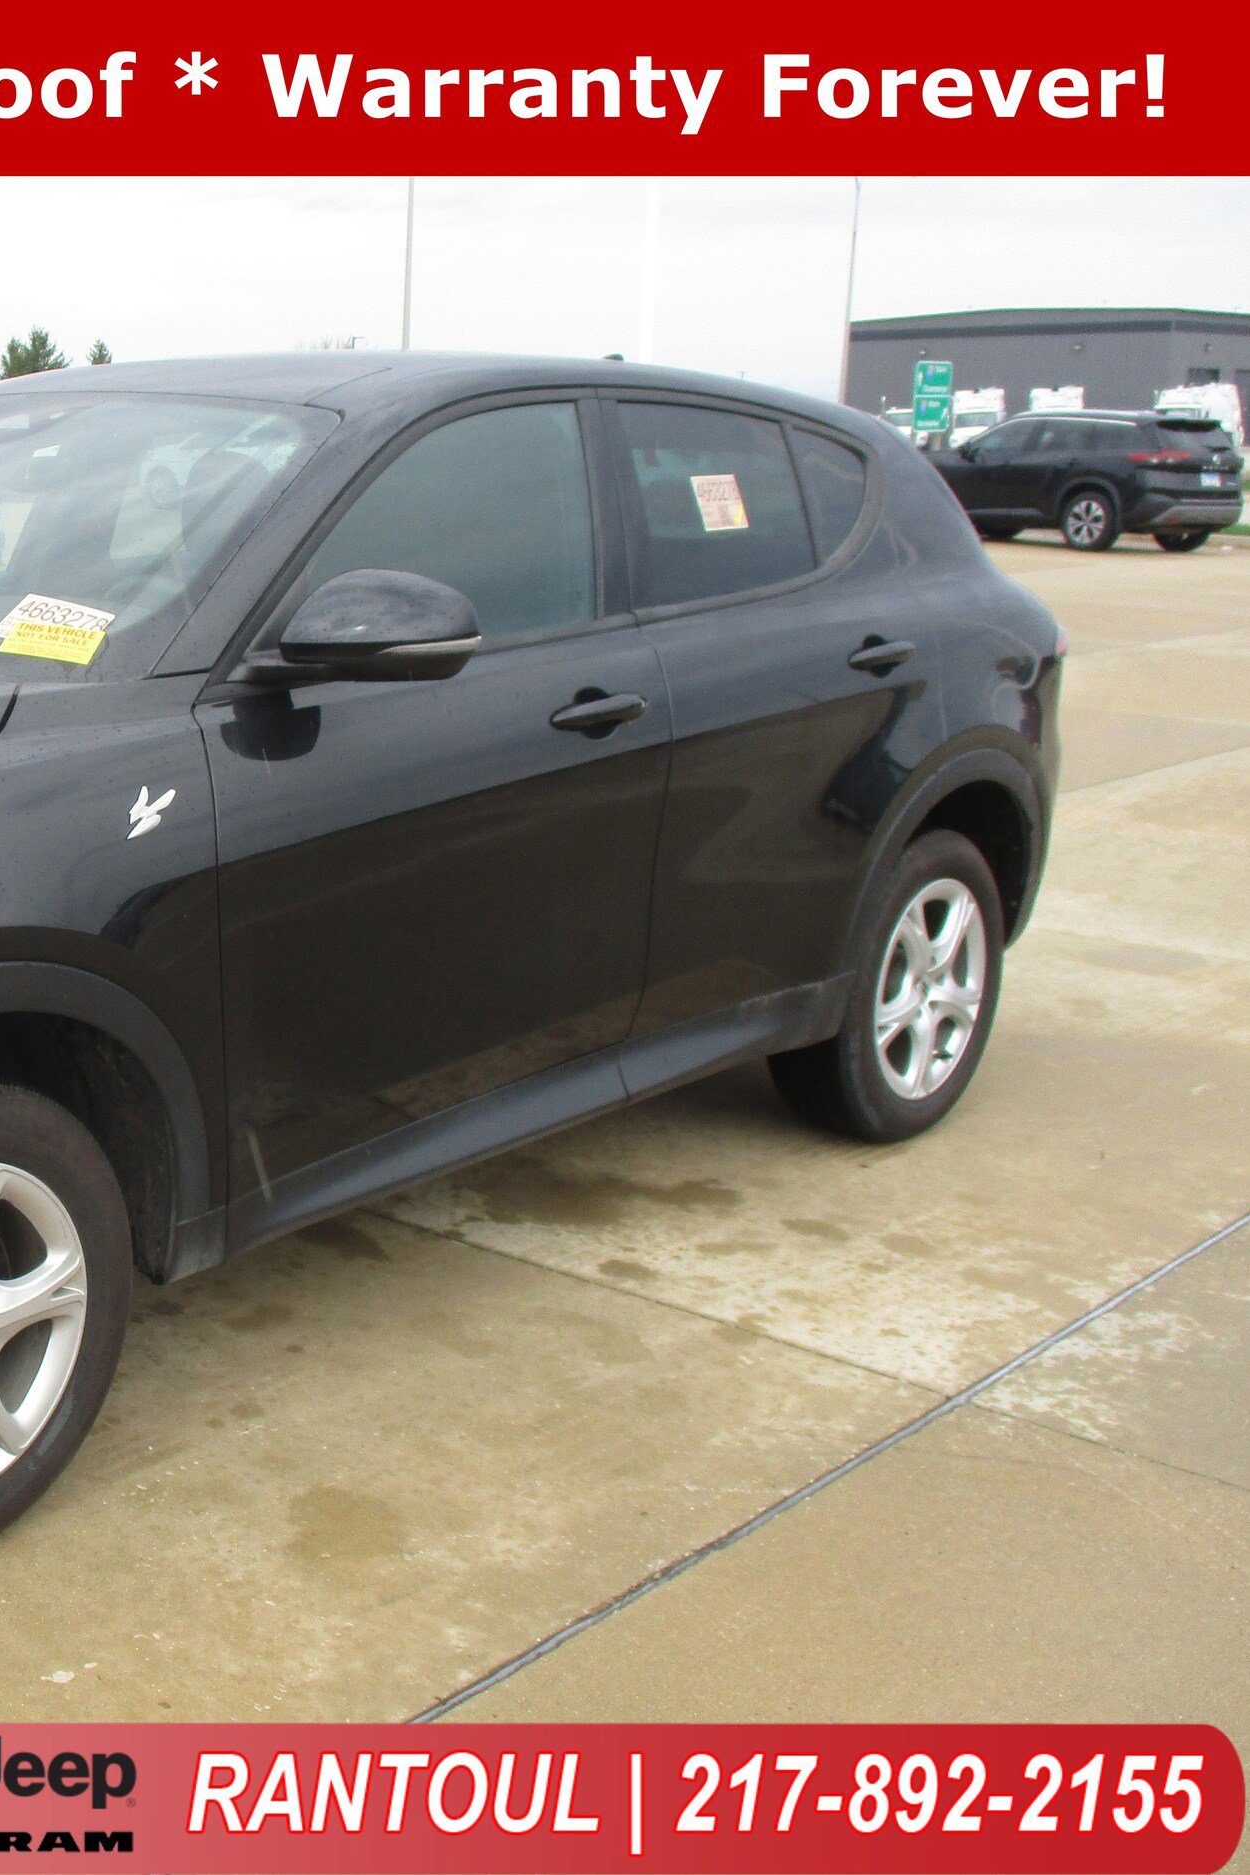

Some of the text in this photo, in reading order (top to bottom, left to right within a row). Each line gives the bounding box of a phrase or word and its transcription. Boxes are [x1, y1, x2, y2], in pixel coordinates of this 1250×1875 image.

[16, 631, 37, 639] NOT
[39, 633, 60, 642] FOR
[19, 622, 45, 632] THIS
[48, 625, 98, 640] VEHICLE
